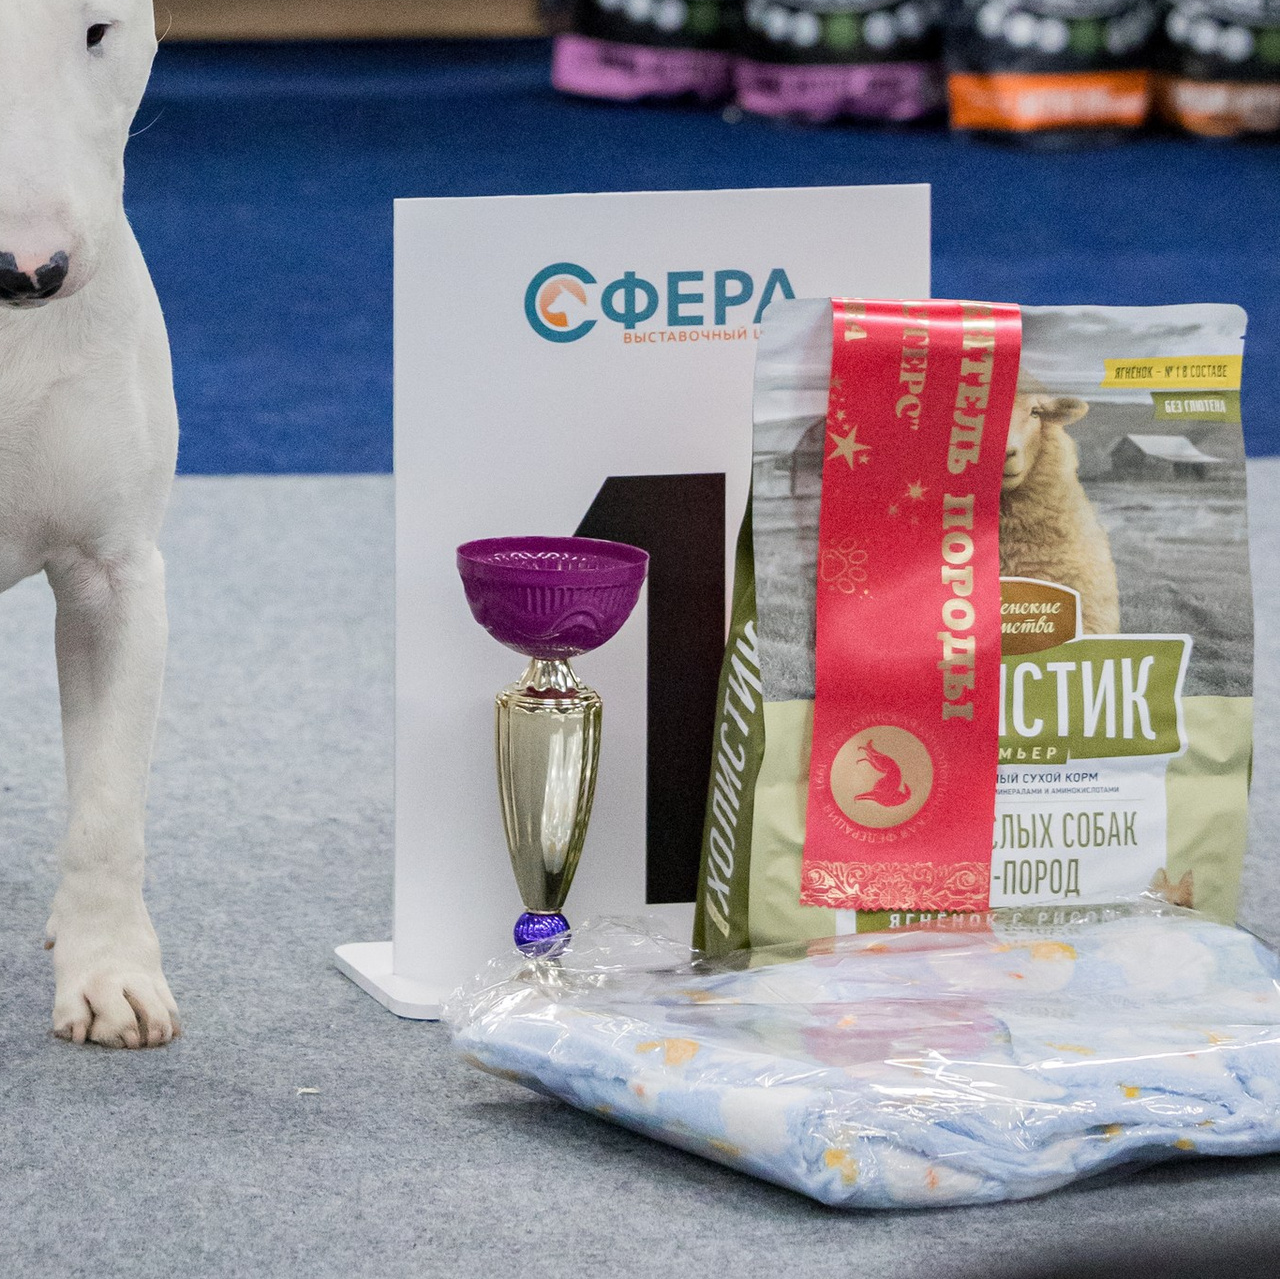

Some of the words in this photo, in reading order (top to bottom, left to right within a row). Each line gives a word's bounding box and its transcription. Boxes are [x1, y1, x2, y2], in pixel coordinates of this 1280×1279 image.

[623, 327, 747, 343] ВЫСТАВОЧНЫЙ
[1190, 364, 1228, 378] СОСТАВЕ
[1164, 399, 1183, 413] БЕЗ
[1184, 399, 1227, 413] ГЛЮТЕНА
[937, 493, 976, 721] ПОРОДЫ
[1000, 601, 1061, 615] енские
[570, 473, 726, 905] 1
[1022, 772, 1061, 784] СУХОЙ
[1065, 772, 1099, 782] КОРМ
[1051, 786, 1120, 795] АМИНОКИСЛОТАМИ
[993, 812, 1054, 849] ЛЫХ
[1062, 811, 1138, 848] СОБАК
